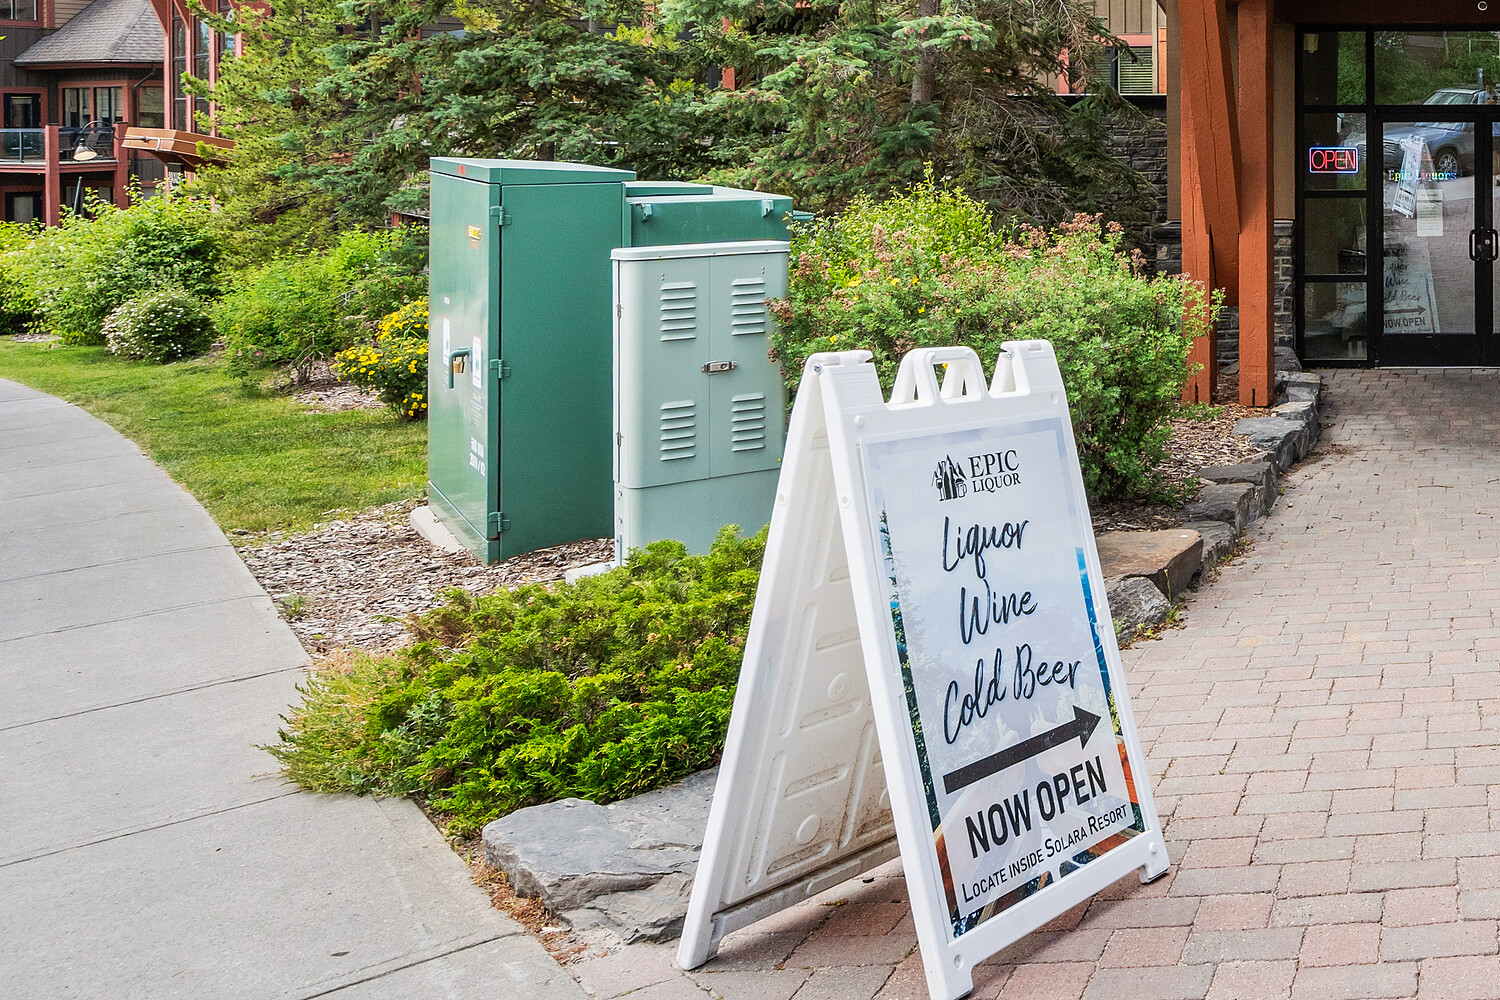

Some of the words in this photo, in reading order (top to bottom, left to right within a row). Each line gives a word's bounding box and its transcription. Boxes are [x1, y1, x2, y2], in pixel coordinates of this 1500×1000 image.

[1311, 150, 1356, 169] OPEN
[1387, 169, 1411, 182] Epic
[1415, 169, 1457, 182] Liquors
[1402, 317, 1426, 327] OPEN
[968, 450, 1020, 478] EPIC
[971, 473, 1022, 494] LIQUOR
[942, 516, 1030, 579] Liquor
[959, 578, 1038, 645] Wine
[943, 648, 1008, 744] Cold
[1014, 643, 1082, 700] Beer
[964, 790, 1031, 859] NOW
[1036, 756, 1107, 821] OPEN
